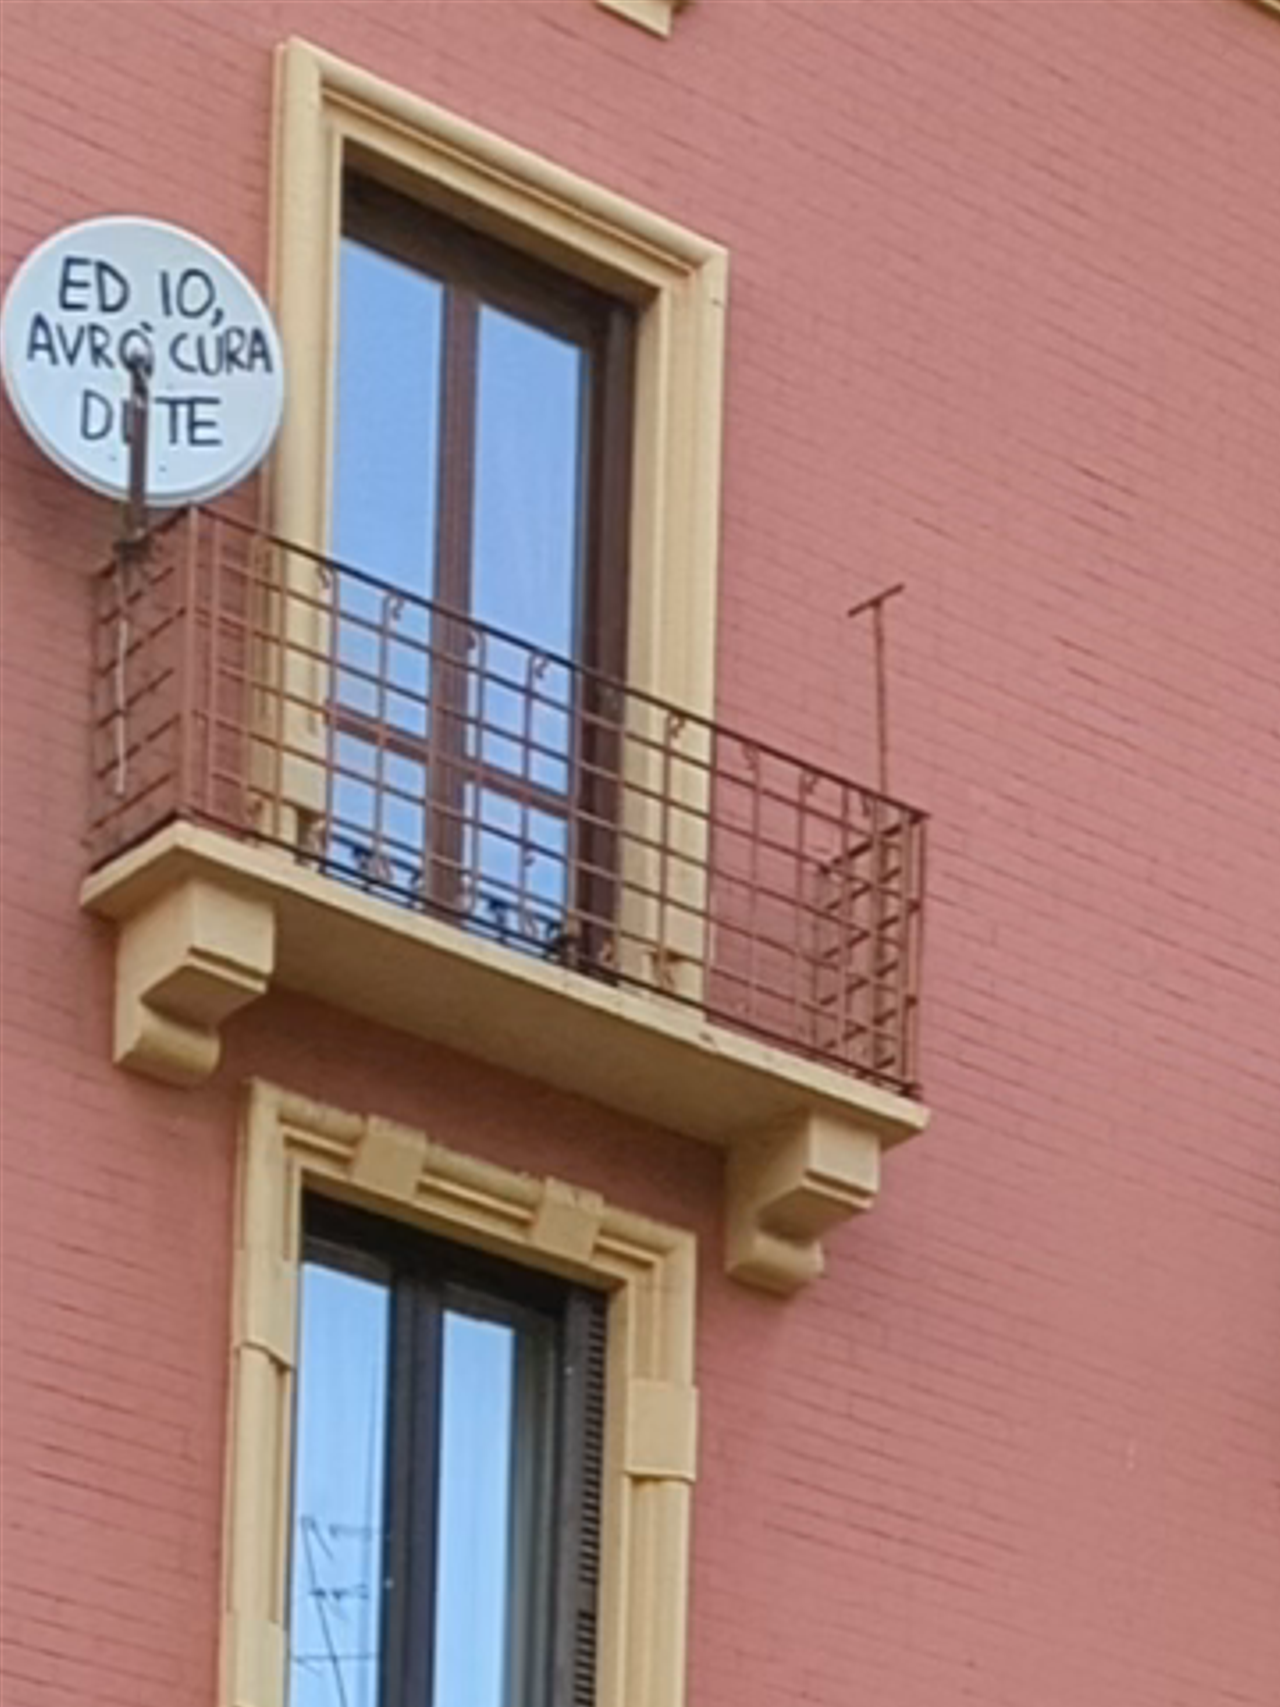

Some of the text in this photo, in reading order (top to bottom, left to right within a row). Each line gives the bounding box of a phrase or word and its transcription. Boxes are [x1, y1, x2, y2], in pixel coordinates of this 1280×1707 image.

[58, 255, 131, 313] ED
[169, 328, 275, 377] CURA
[155, 396, 223, 447] TE
